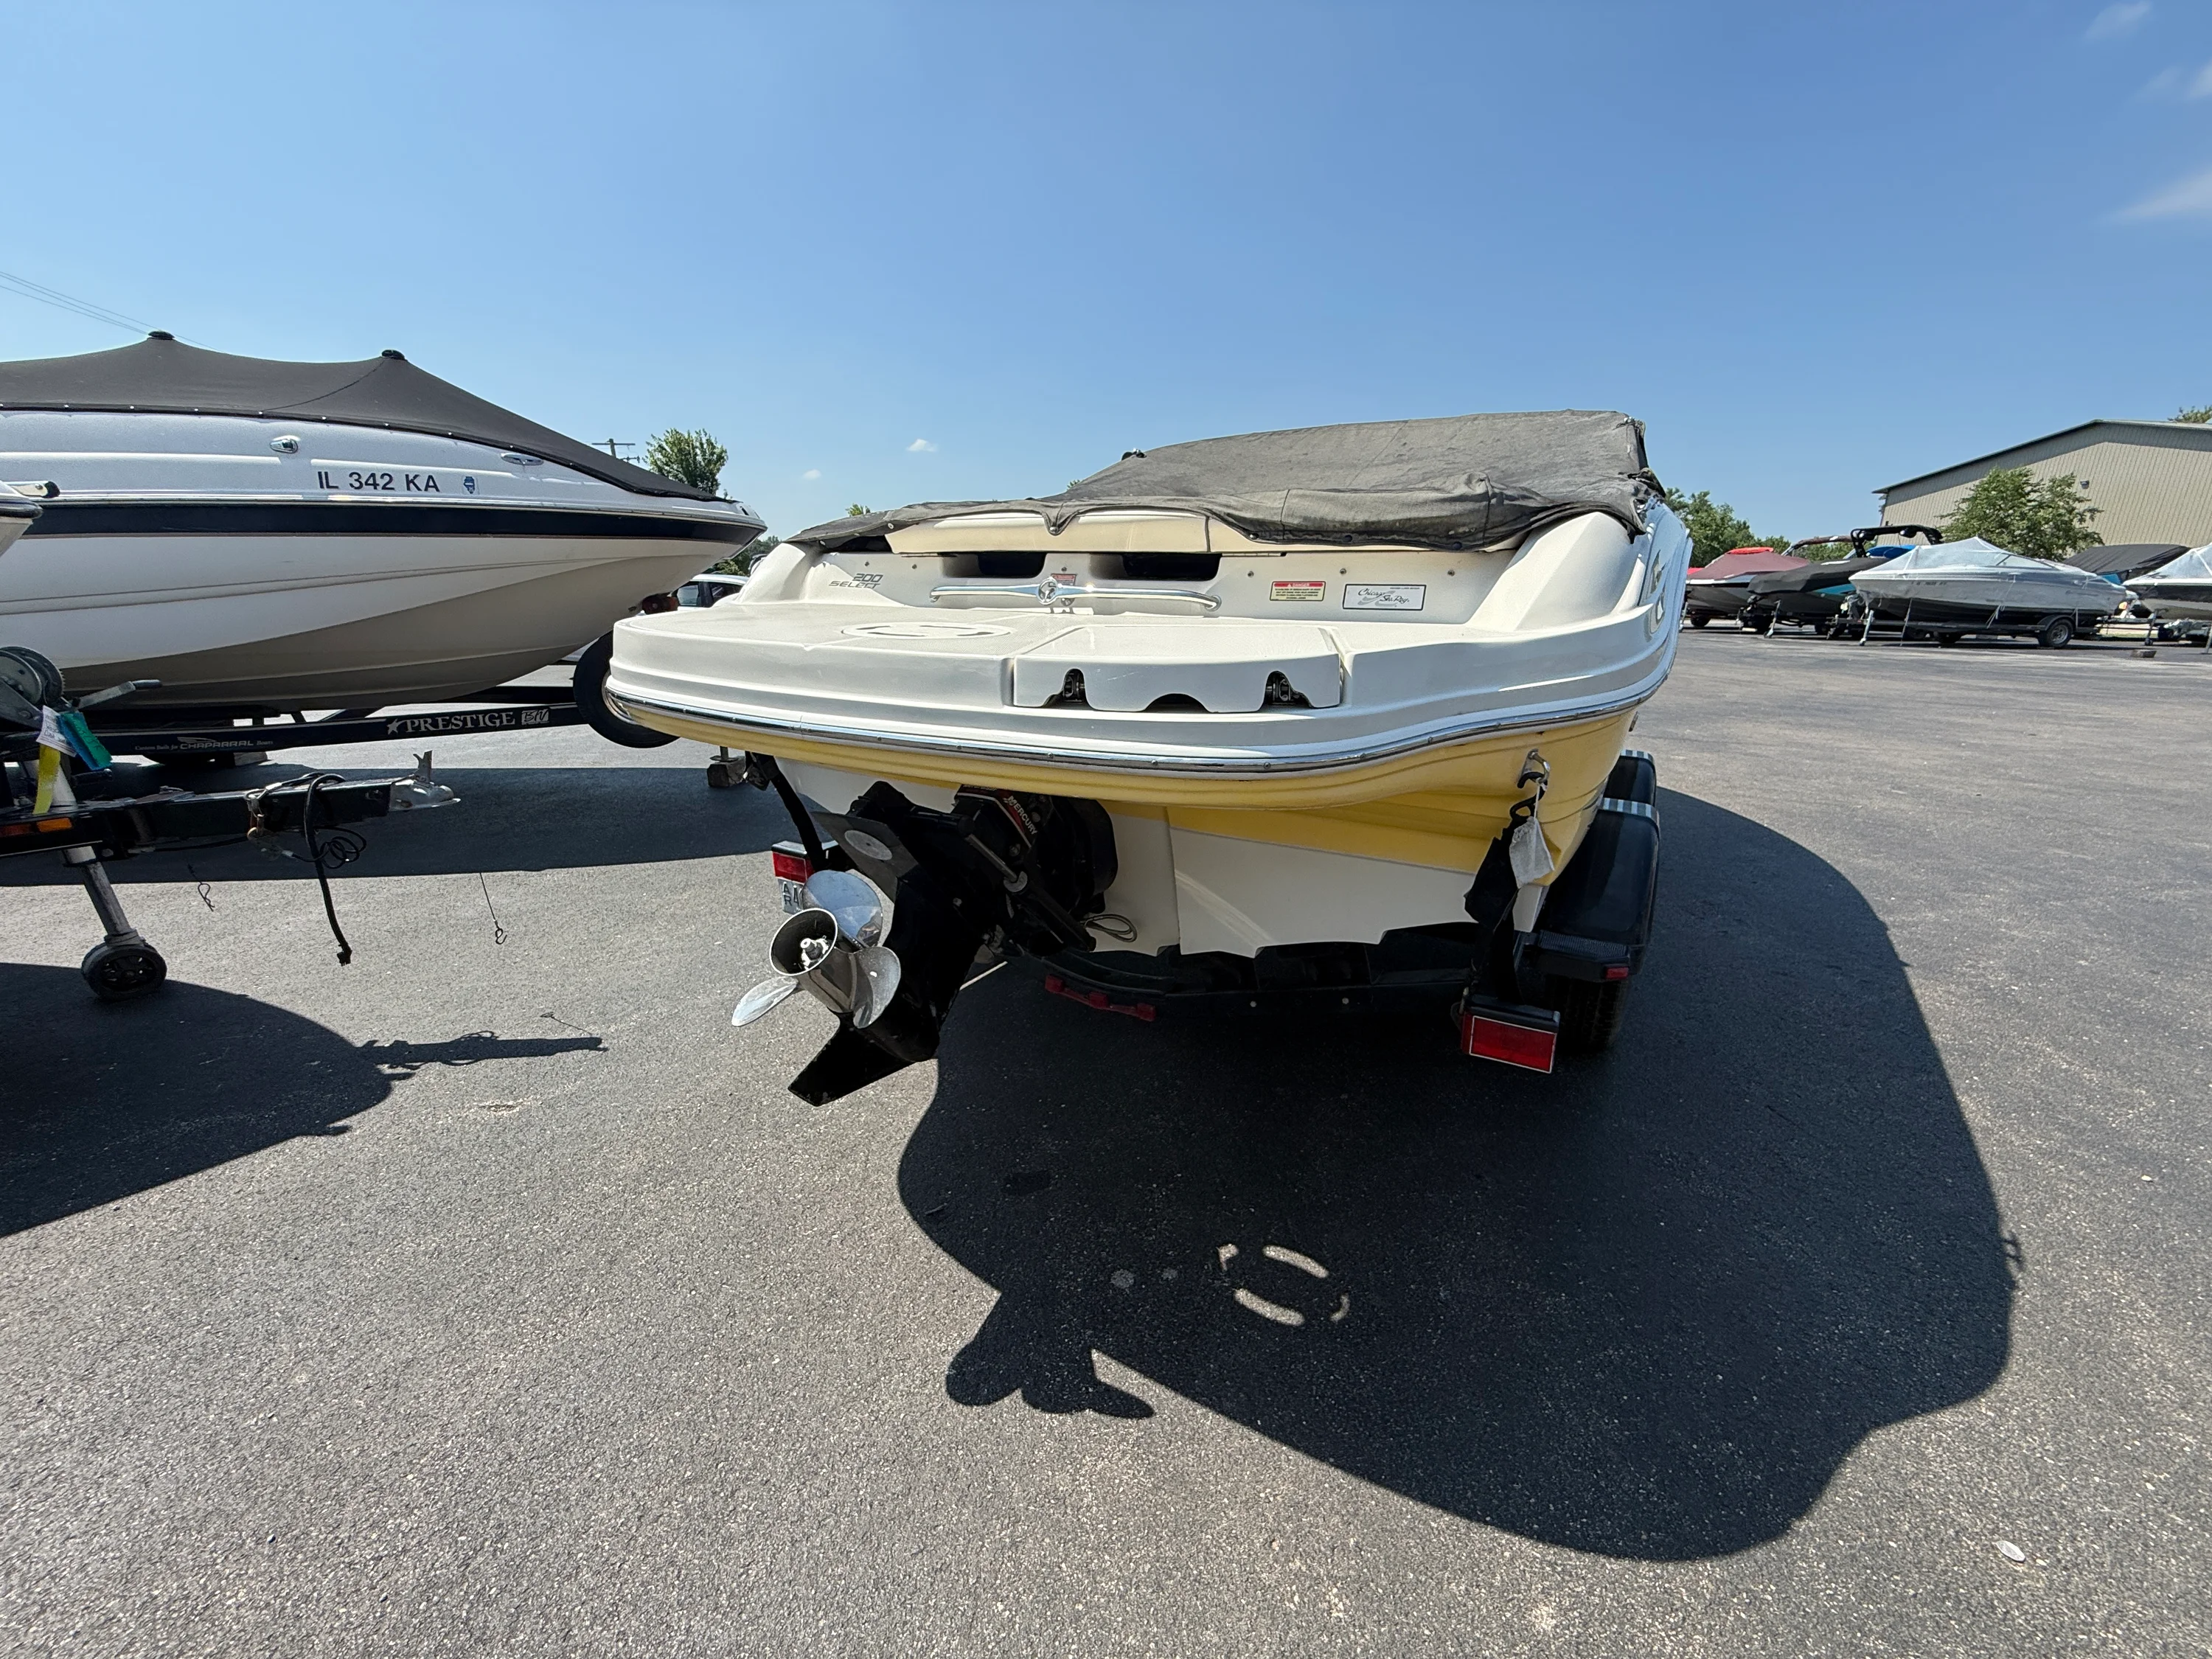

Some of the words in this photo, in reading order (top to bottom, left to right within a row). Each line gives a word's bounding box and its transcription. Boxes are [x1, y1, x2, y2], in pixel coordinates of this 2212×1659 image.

[318, 471, 338, 490] IL
[349, 472, 395, 490] 342
[405, 473, 440, 493] KA
[829, 580, 880, 588] SELECT
[852, 573, 883, 582] 200
[404, 712, 515, 732] PRESTIGE
[180, 740, 254, 750] CHAPARRAL
[1004, 796, 1037, 835] MERCURY
